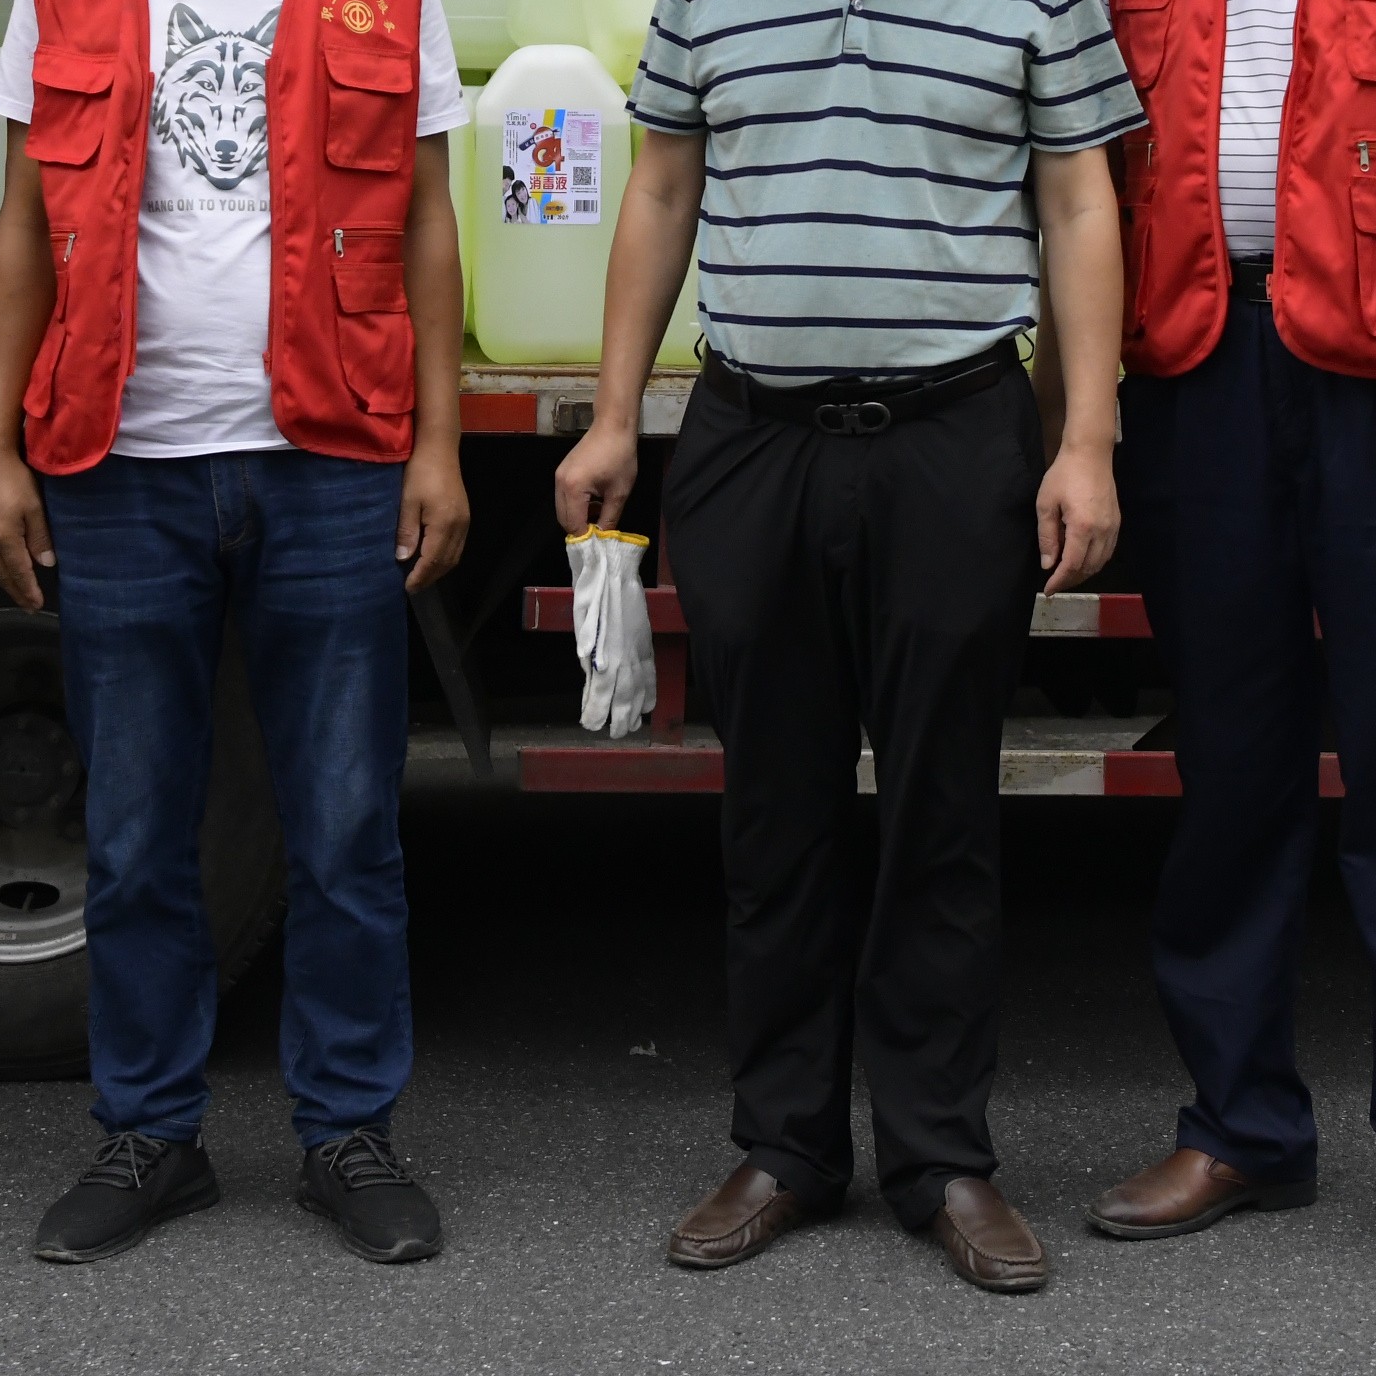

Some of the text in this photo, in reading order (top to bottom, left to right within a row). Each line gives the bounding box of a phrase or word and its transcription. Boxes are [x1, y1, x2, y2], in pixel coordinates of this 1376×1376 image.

[529, 176, 567, 190] 消毒液
[147, 199, 174, 213] HANG
[177, 199, 194, 211] ON
[199, 199, 215, 211] TO
[219, 199, 255, 211] YOUR
